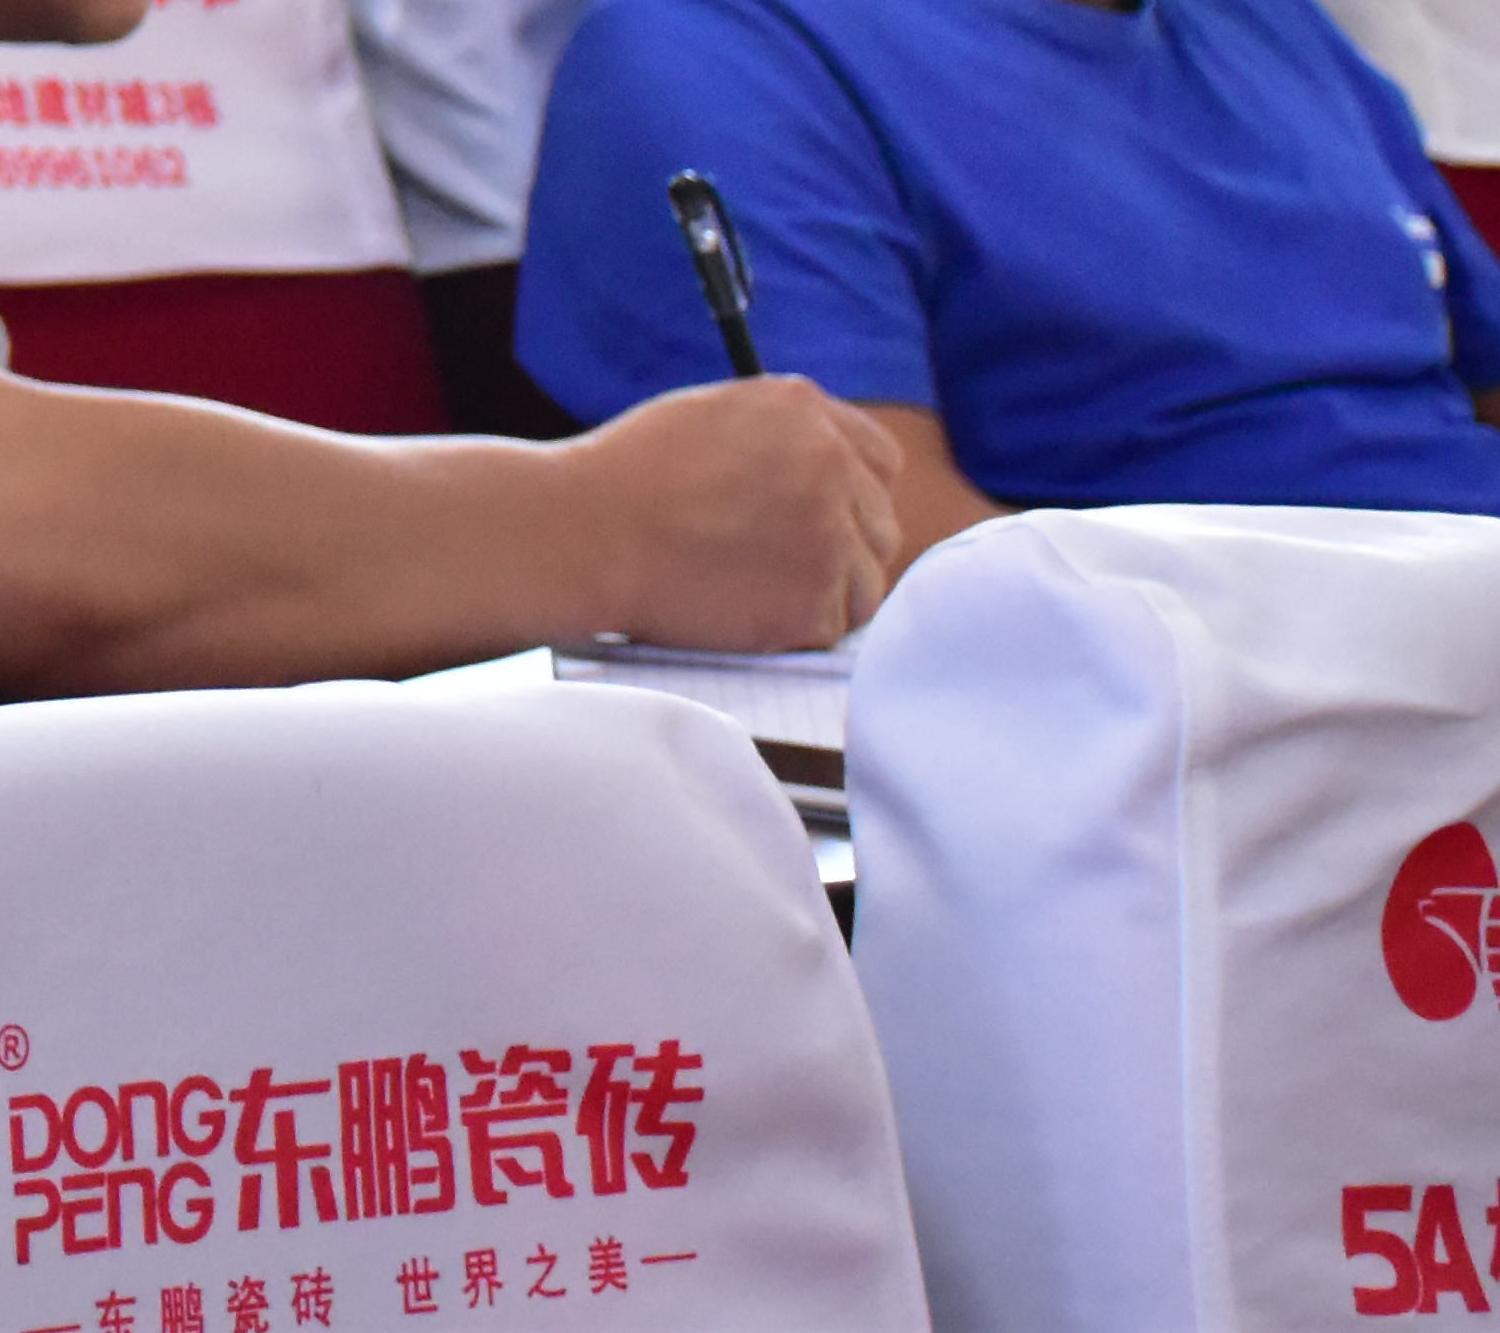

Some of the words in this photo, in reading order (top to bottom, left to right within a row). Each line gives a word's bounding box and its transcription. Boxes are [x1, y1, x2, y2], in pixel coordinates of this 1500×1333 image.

[8, 1074, 227, 1175] DONG
[228, 1039, 705, 1232] 东鹏瓷砖
[13, 1160, 215, 1266] PENG
[1340, 1183, 1500, 1317] 5A
[94, 1265, 336, 1333] 东鹏瓷砖
[395, 1235, 629, 1315] 世界之美
